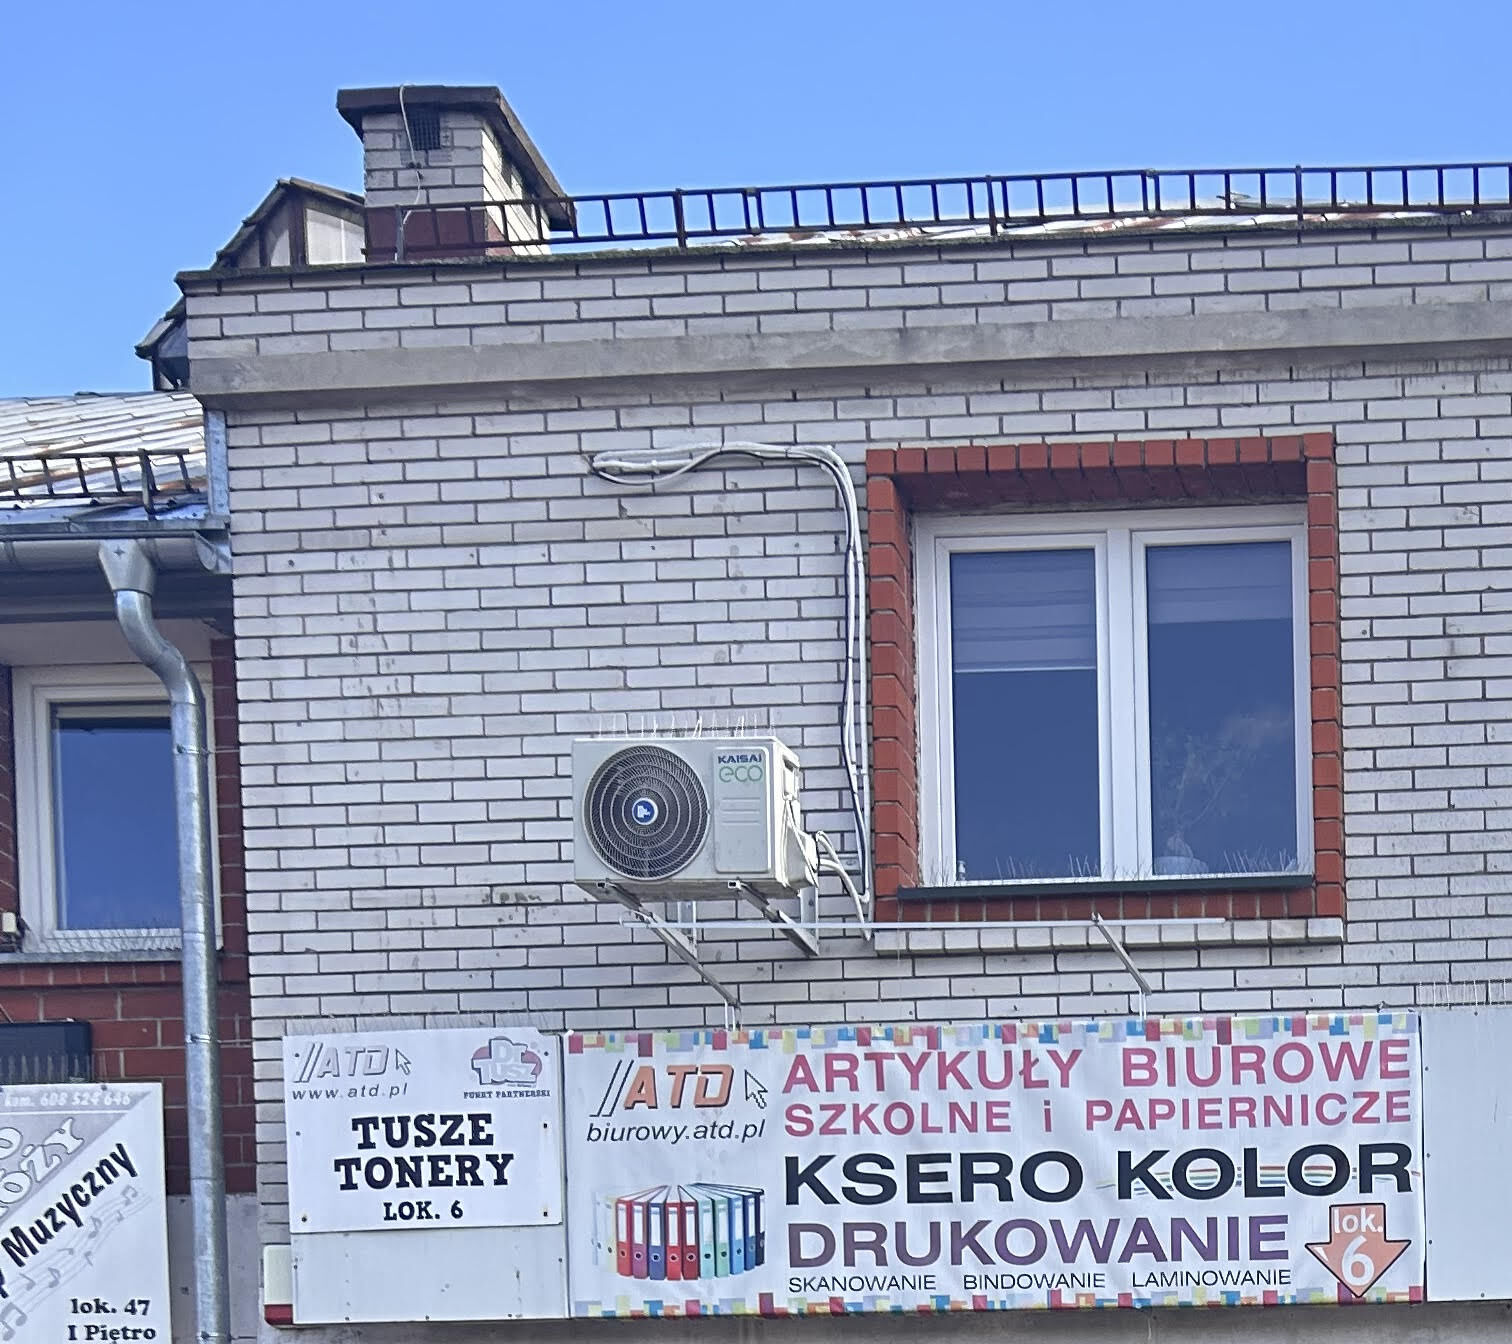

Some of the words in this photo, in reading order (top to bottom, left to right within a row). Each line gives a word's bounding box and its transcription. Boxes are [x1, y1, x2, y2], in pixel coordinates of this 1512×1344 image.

[718, 753, 763, 764] KAISAI
[719, 765, 763, 783] eco
[782, 1049, 1083, 1094] ARTYKUŁY
[1122, 1039, 1411, 1087] BIUROWE
[292, 1083, 408, 1100] www.atd.pl
[784, 1101, 1012, 1137] SZKOLNE
[1042, 1101, 1052, 1132] i
[1086, 1091, 1412, 1131] PAPIERNICZE
[351, 1113, 495, 1150] TUSZE
[586, 1119, 766, 1144] biurowy.atd.pl
[333, 1153, 515, 1191] TONERY
[785, 1151, 1084, 1205] KSERO
[1116, 1143, 1413, 1200] KOLOR
[1, 1143, 137, 1268] Muzyczny
[383, 1201, 440, 1222] LOK.
[449, 1201, 464, 1220] 6
[1333, 1208, 1382, 1234] lok.
[789, 1215, 1289, 1268] DRUKOWANIE
[1341, 1237, 1374, 1286] 6
[789, 1275, 936, 1292] SKANOWANIE
[963, 1272, 1105, 1290] BINDOWANIE
[1132, 1269, 1291, 1288] LAMINOWANIE
[70, 1298, 117, 1314] lok.
[124, 1299, 150, 1315] 47
[68, 1325, 77, 1340] I
